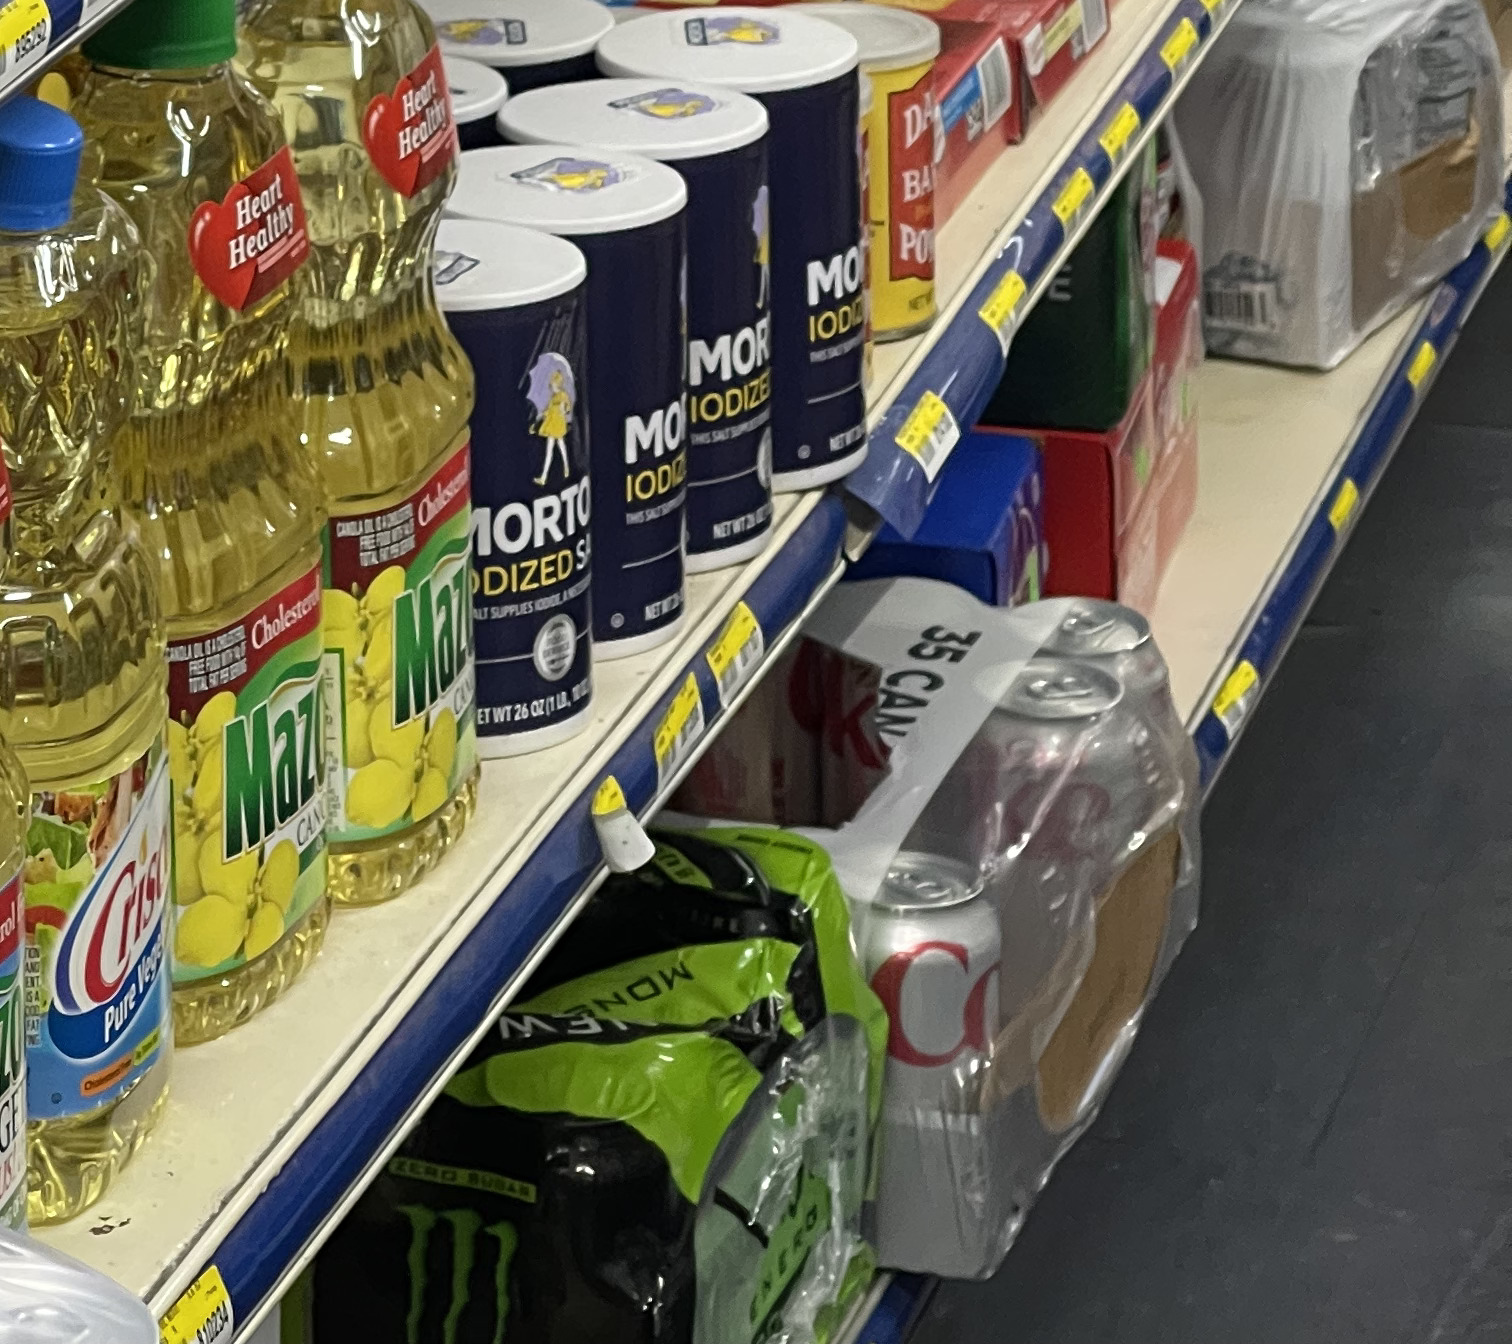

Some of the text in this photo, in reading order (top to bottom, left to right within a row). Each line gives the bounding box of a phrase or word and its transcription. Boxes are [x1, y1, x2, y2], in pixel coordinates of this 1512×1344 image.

[401, 72, 437, 116] Heart
[236, 176, 282, 224] Heart
[228, 204, 294, 271] Healthy
[908, 625, 983, 664] 35
[493, 702, 528, 723] WT 26
[105, 991, 136, 1044] Pure
